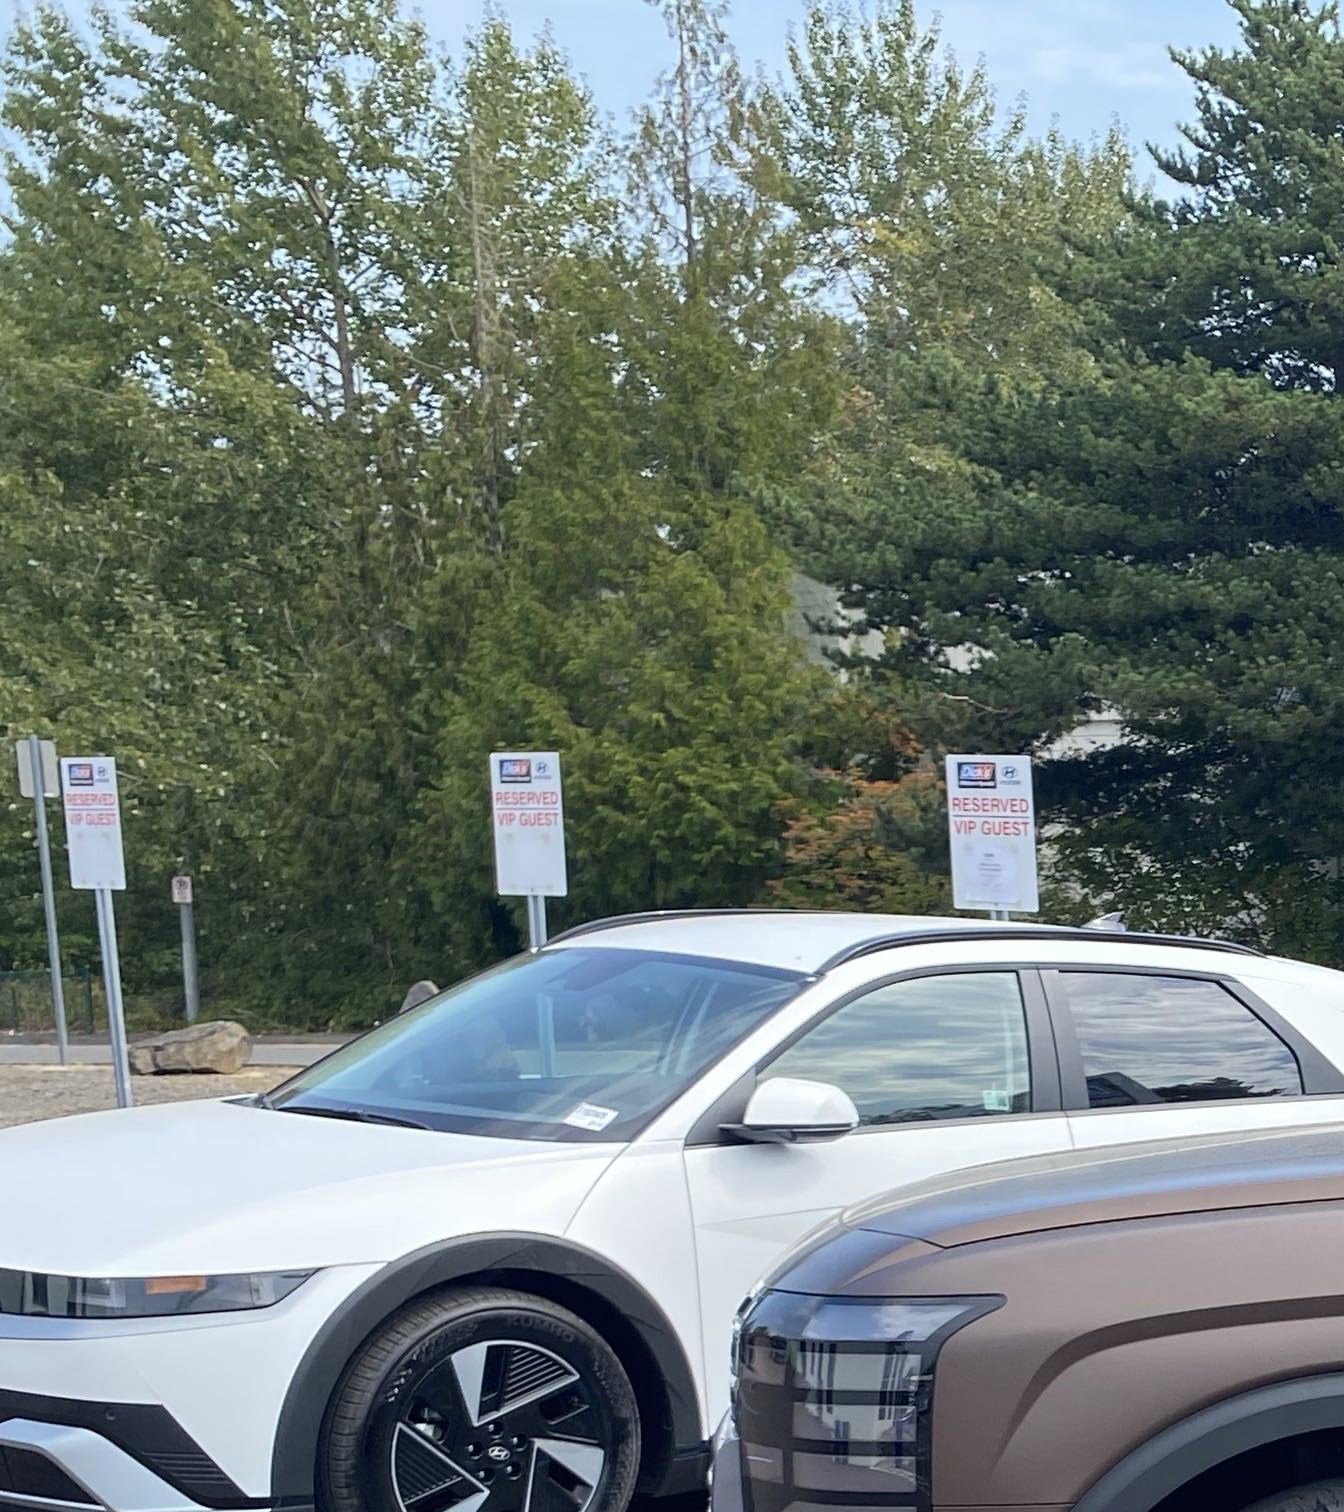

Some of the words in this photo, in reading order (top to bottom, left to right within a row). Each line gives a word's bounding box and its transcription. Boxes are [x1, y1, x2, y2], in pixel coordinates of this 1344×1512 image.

[496, 791, 558, 805] RESERVED
[952, 798, 1029, 813] RESERVED
[520, 813, 559, 826] GUEST
[953, 821, 977, 835] VIP
[981, 821, 1030, 836] GUEST
